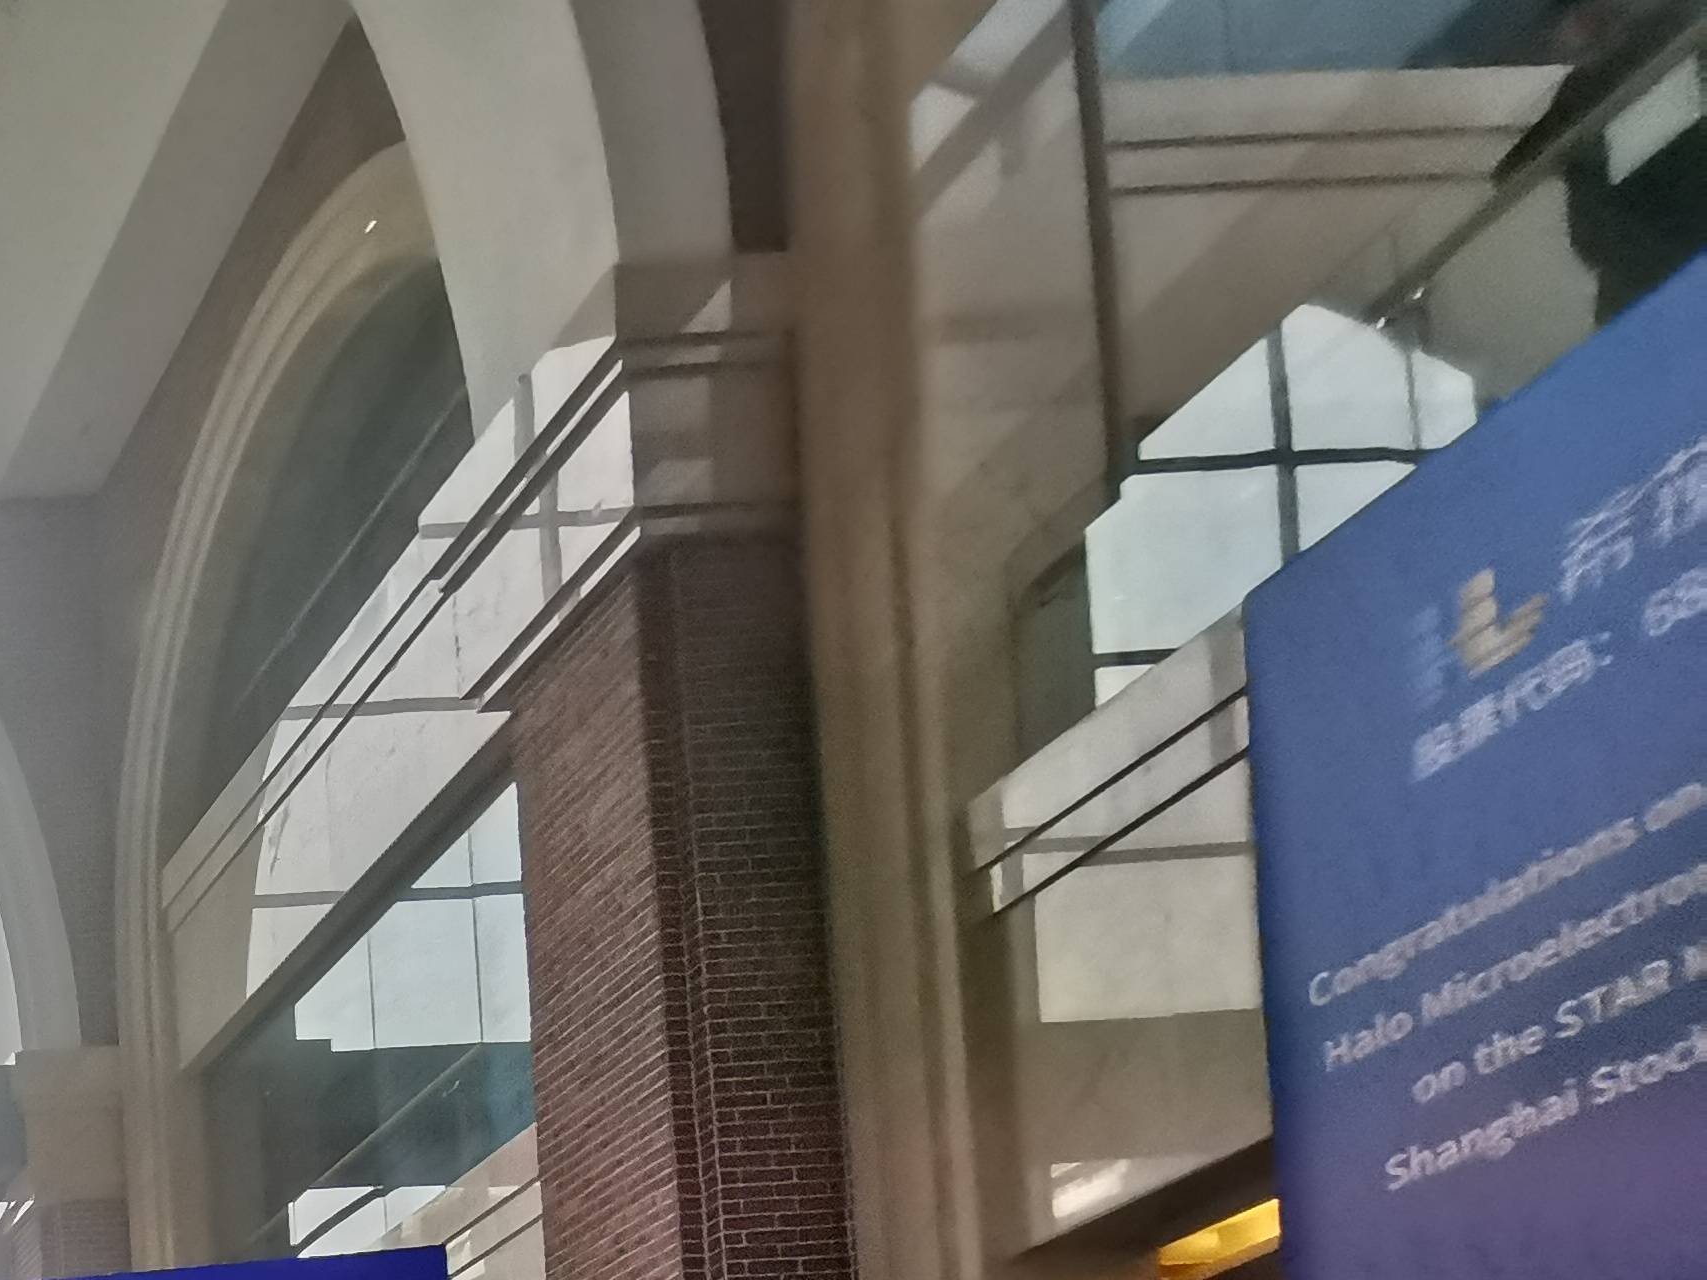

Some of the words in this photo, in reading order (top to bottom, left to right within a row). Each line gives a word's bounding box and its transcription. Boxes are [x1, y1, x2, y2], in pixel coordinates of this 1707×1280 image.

[1309, 817, 1640, 1006] Congratulations
[1325, 1011, 1413, 1071] Halo
[1412, 1061, 1466, 1103] on
[1474, 1026, 1547, 1074] the
[1555, 959, 1670, 1038] STAR
[1385, 1077, 1579, 1191] Shanghai
